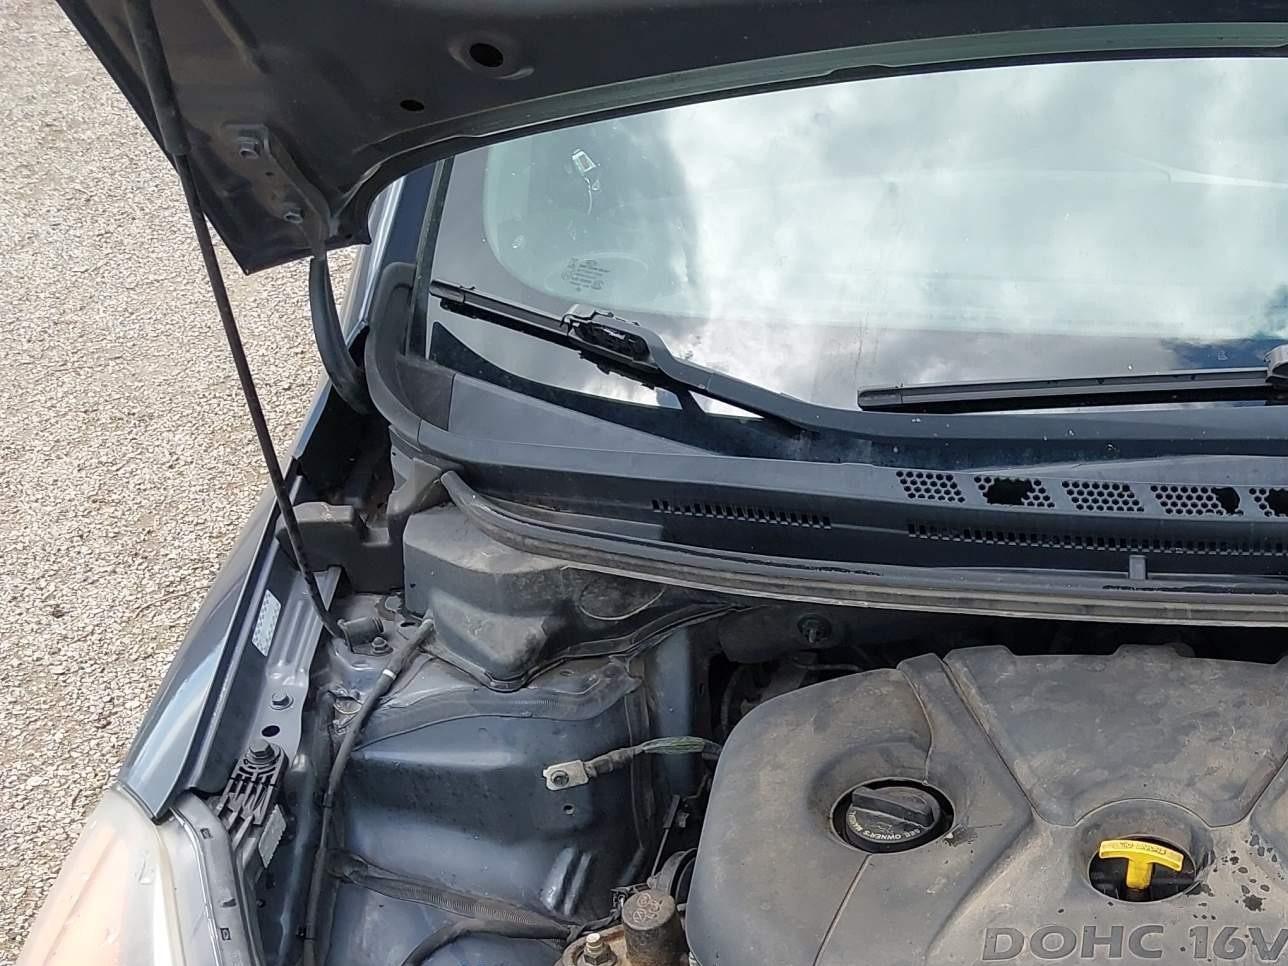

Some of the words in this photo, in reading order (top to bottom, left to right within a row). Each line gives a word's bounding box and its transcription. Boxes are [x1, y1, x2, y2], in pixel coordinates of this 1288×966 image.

[863, 830, 902, 840] OWNER'S
[903, 828, 921, 838] SEE
[982, 924, 1165, 961] DOHC
